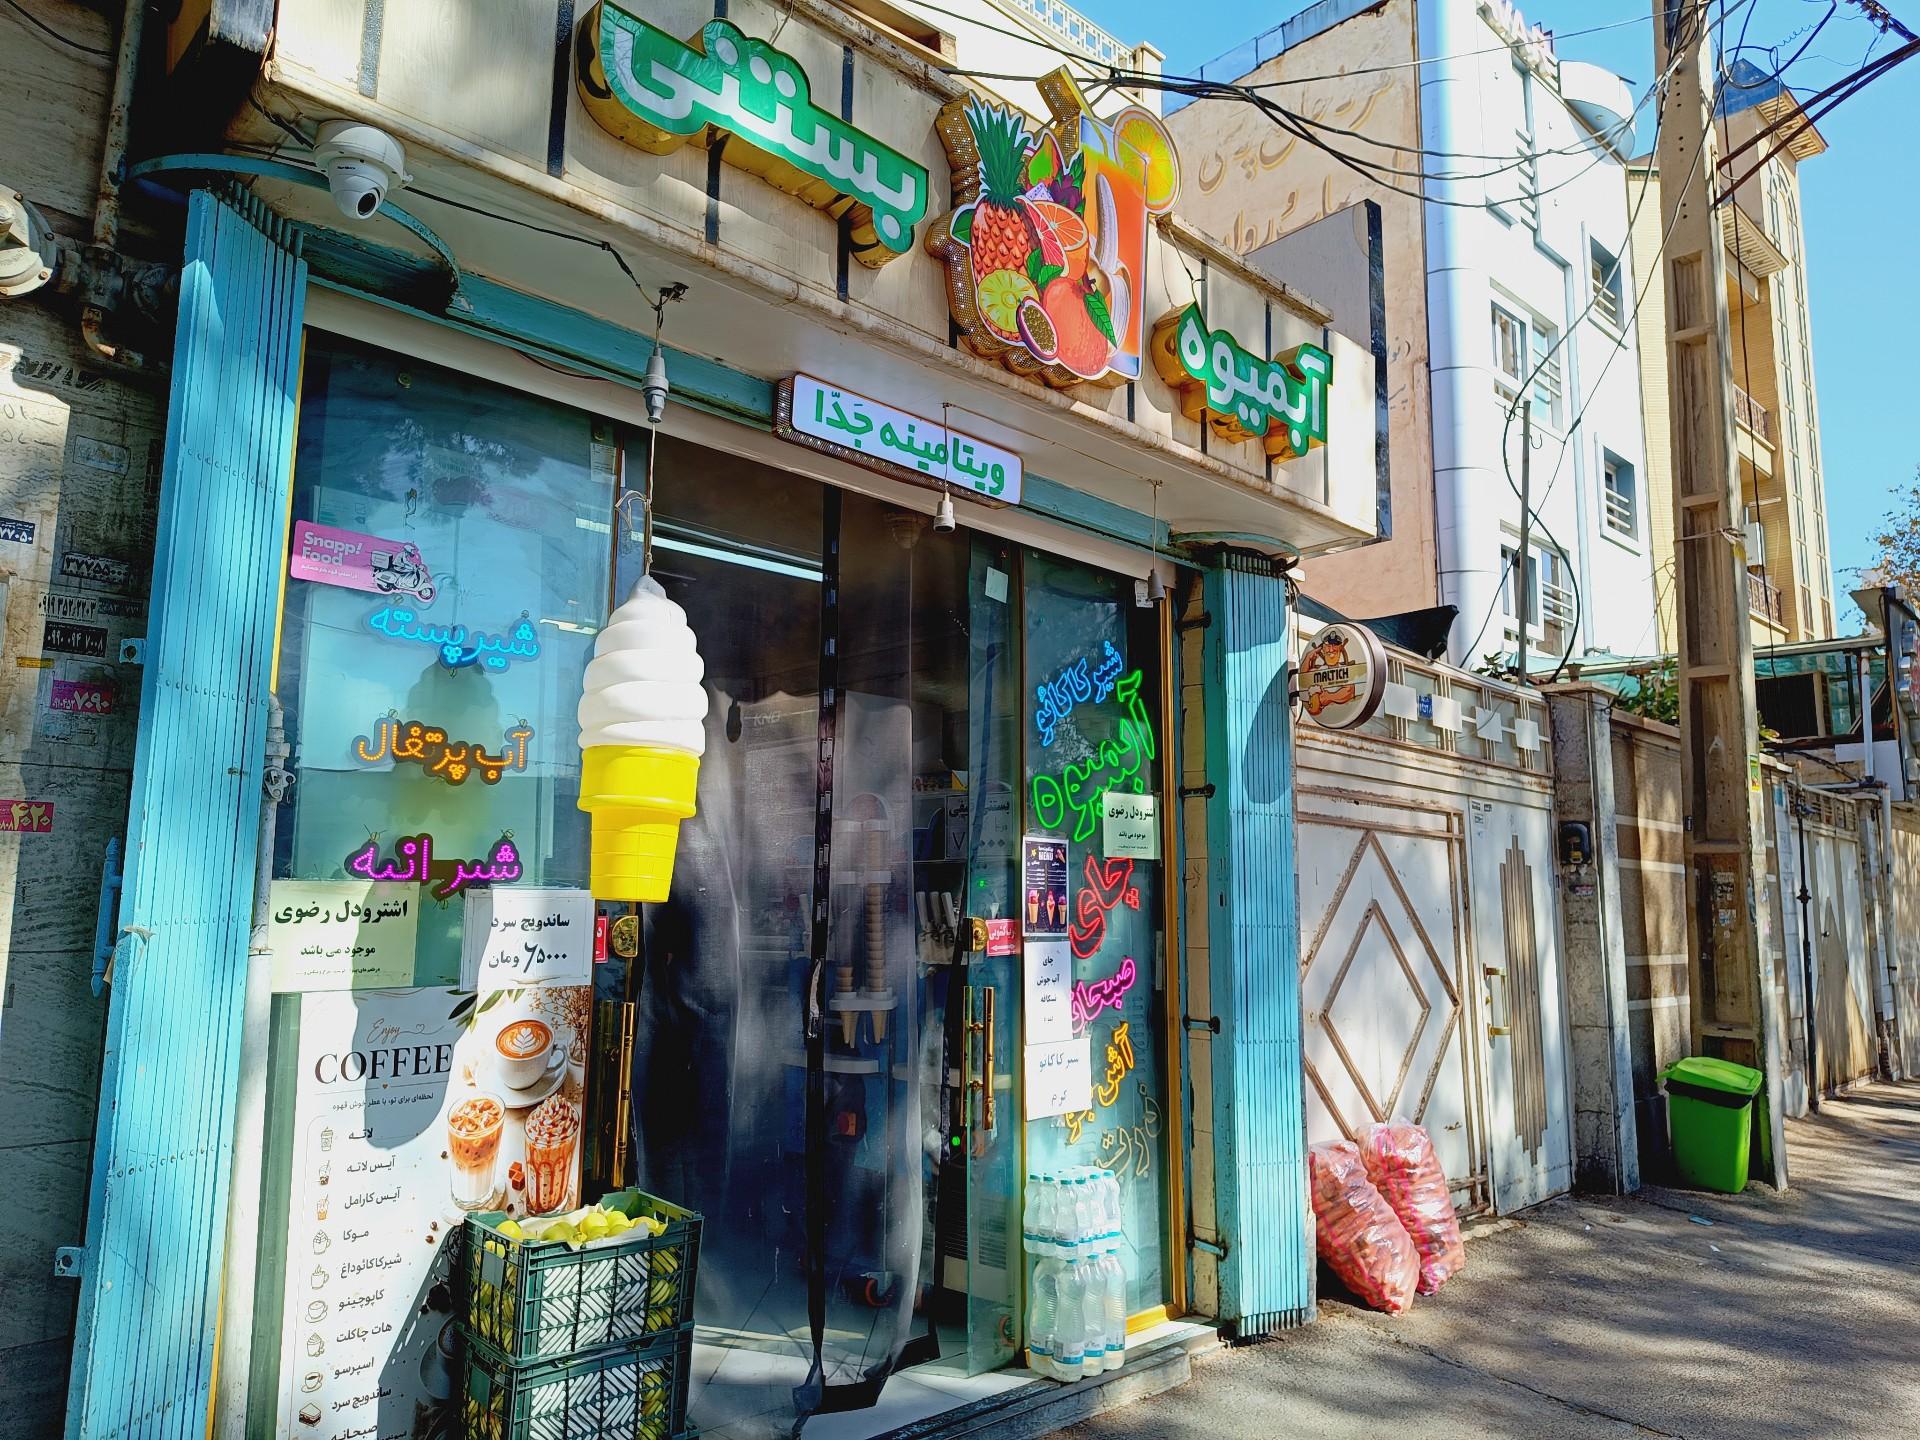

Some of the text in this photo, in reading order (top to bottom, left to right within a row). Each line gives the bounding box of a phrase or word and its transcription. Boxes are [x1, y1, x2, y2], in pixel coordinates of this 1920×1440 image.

[603, 5, 919, 241] بستنی
[1177, 310, 1334, 454] آبمیوه
[879, 403, 1006, 496] ویتامینه
[303, 531, 363, 555] Snapp!
[301, 546, 343, 566] Food
[369, 607, 539, 668] شیر پسته
[1093, 640, 1123, 704] شیر
[1313, 667, 1349, 684] MALTICH
[358, 722, 532, 780] آب پرتقال
[1108, 804, 1128, 820] رضوی
[274, 899, 409, 924] اشترودل رضوی
[1068, 855, 1141, 959] چای
[490, 913, 571, 933] ساندویچ سرد
[300, 945, 376, 958] موجود می باشد
[523, 941, 568, 974] ۶۵۰۰۰
[1042, 956, 1054, 967] چای
[1036, 973, 1061, 986] آب جوش
[1069, 958, 1137, 1034] صبحان
[366, 1017, 402, 1045] Enjoy
[314, 1043, 454, 1085] COFFEE
[1097, 1020, 1135, 1107] آش
[332, 1100, 348, 1111] قهوه
[367, 1098, 381, 1108] عطر
[397, 1095, 411, 1104] برای
[348, 1127, 374, 1140] لاته
[346, 1154, 396, 1173] آیس لاته
[344, 1185, 401, 1210] آیس کارامل
[343, 1229, 369, 1242] موکا
[338, 1288, 385, 1312] کاپوچینو
[336, 1321, 393, 1343] هات چاکلت
[333, 1356, 375, 1379] اسپرسو
[331, 1386, 392, 1413] ساندویچ سرد
